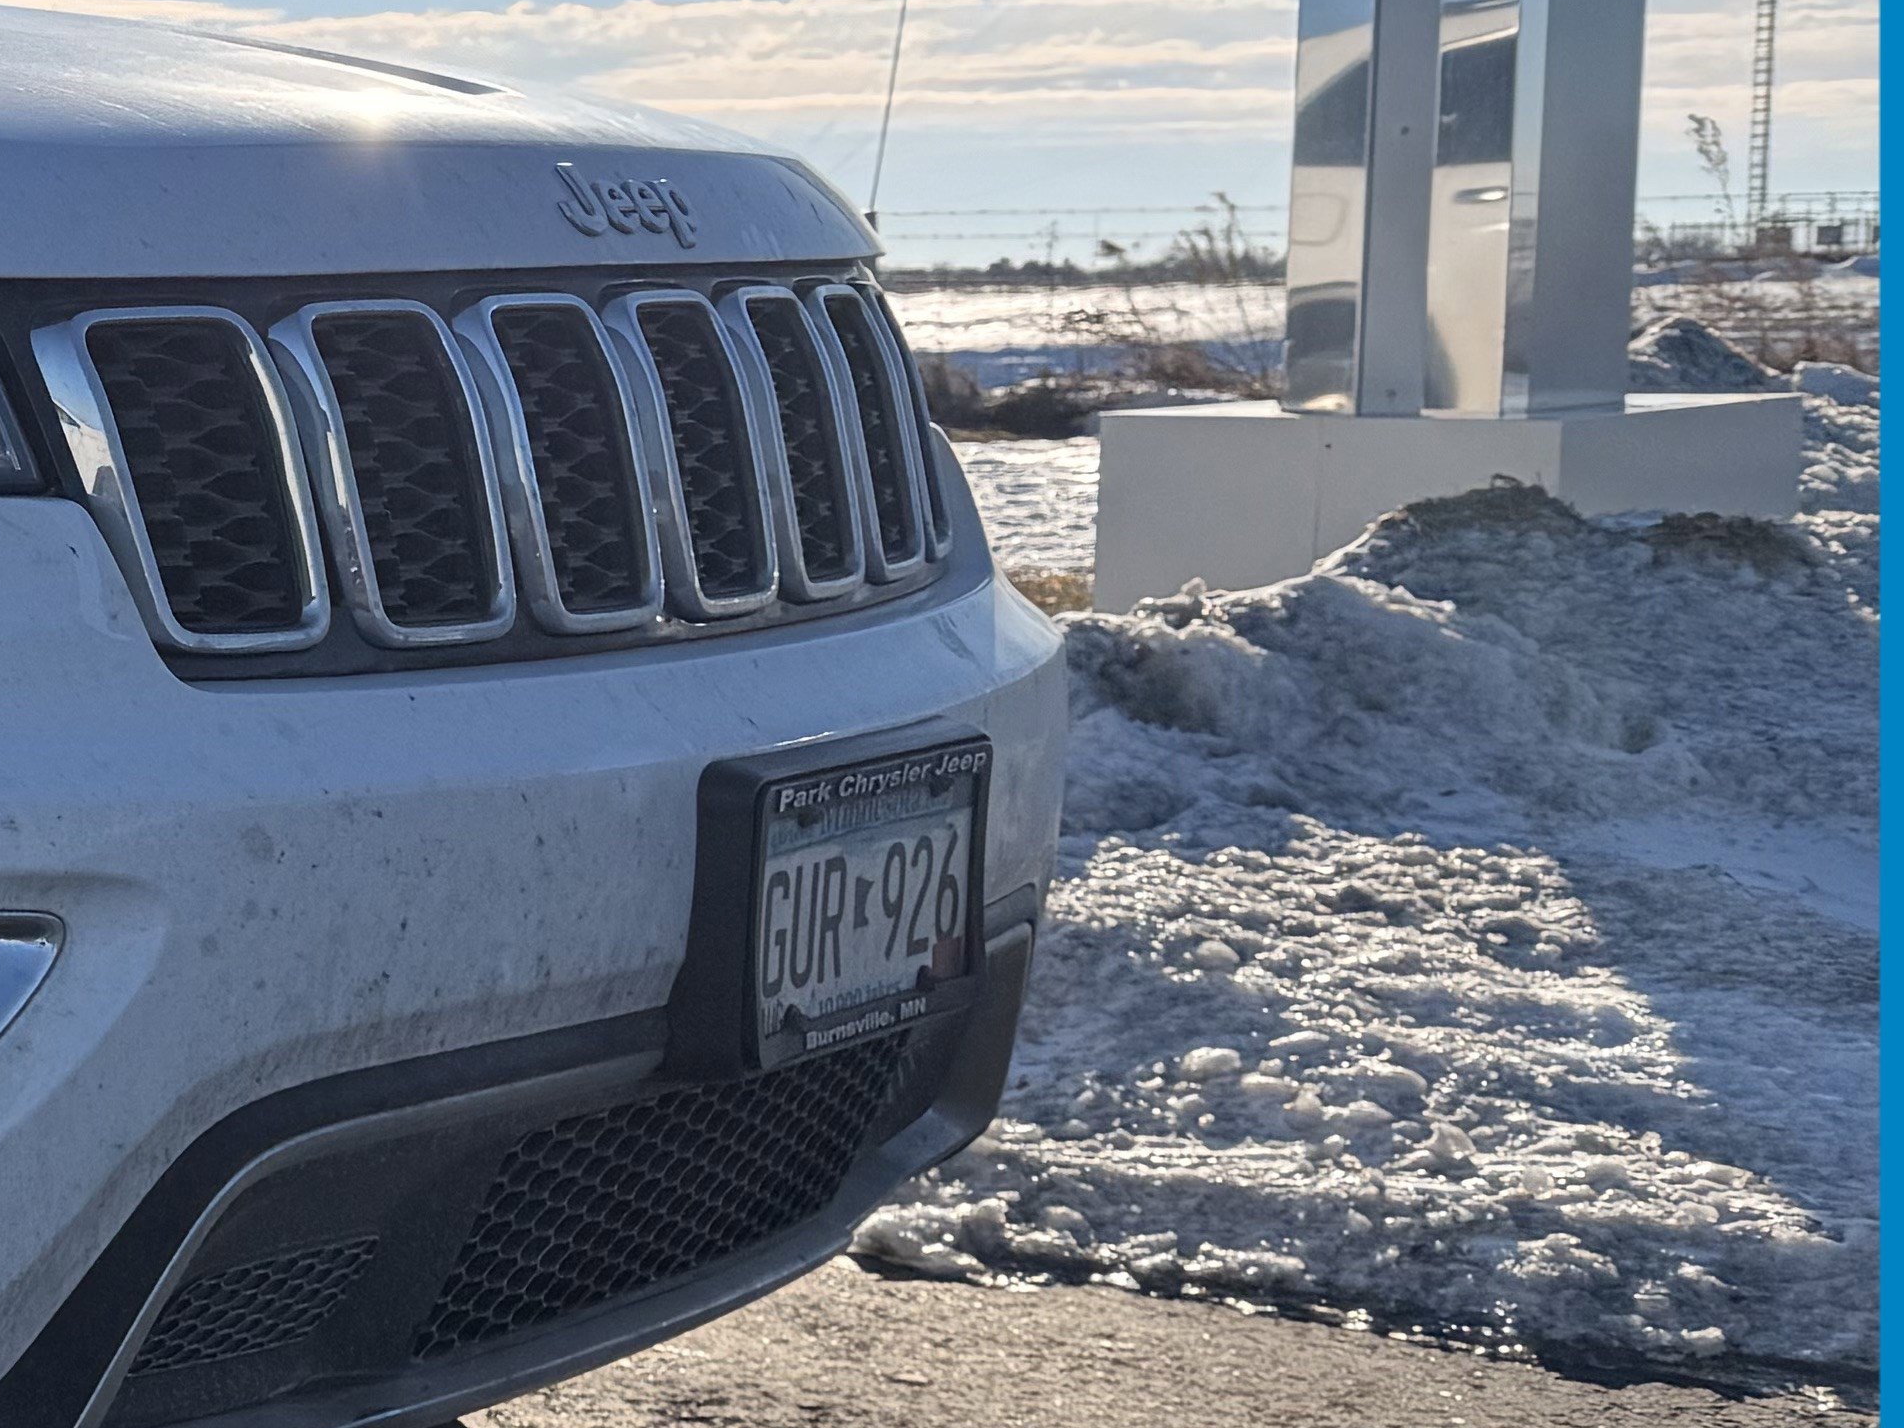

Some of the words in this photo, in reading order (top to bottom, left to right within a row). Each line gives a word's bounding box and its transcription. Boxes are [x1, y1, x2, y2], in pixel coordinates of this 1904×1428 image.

[555, 162, 697, 249] Jeep
[779, 781, 832, 812] Park
[838, 763, 931, 797] Chrysler
[934, 752, 987, 775] Jeep
[762, 856, 847, 998] GUR
[882, 825, 959, 962] 926
[806, 1011, 896, 1050] Burnsville,
[900, 997, 927, 1020] MN
